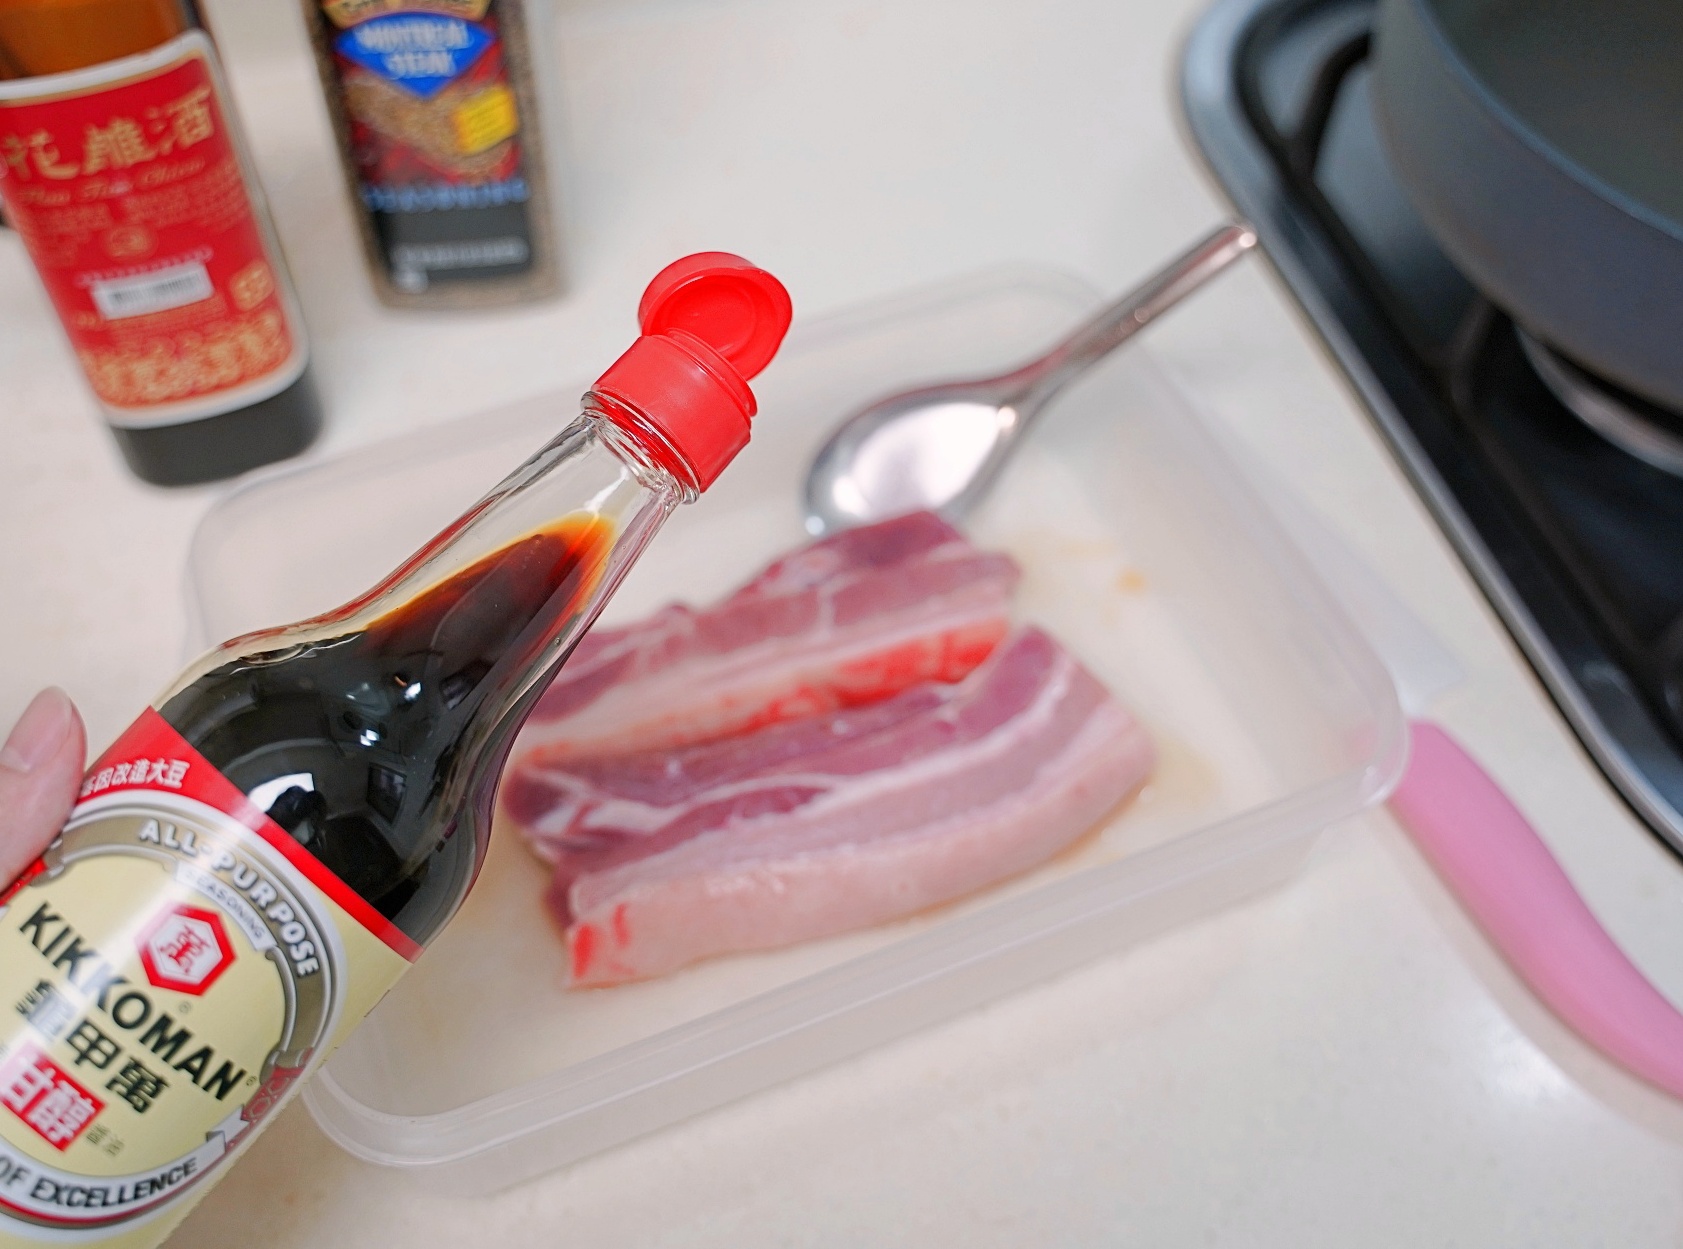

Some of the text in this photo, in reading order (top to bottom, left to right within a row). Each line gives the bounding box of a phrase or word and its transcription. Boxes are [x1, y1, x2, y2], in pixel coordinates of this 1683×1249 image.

[139, 818, 320, 978] ALL-PURPOSE
[18, 901, 247, 1101] KIKKOMAN
[30, 1156, 200, 1208] EXCELLENCE
